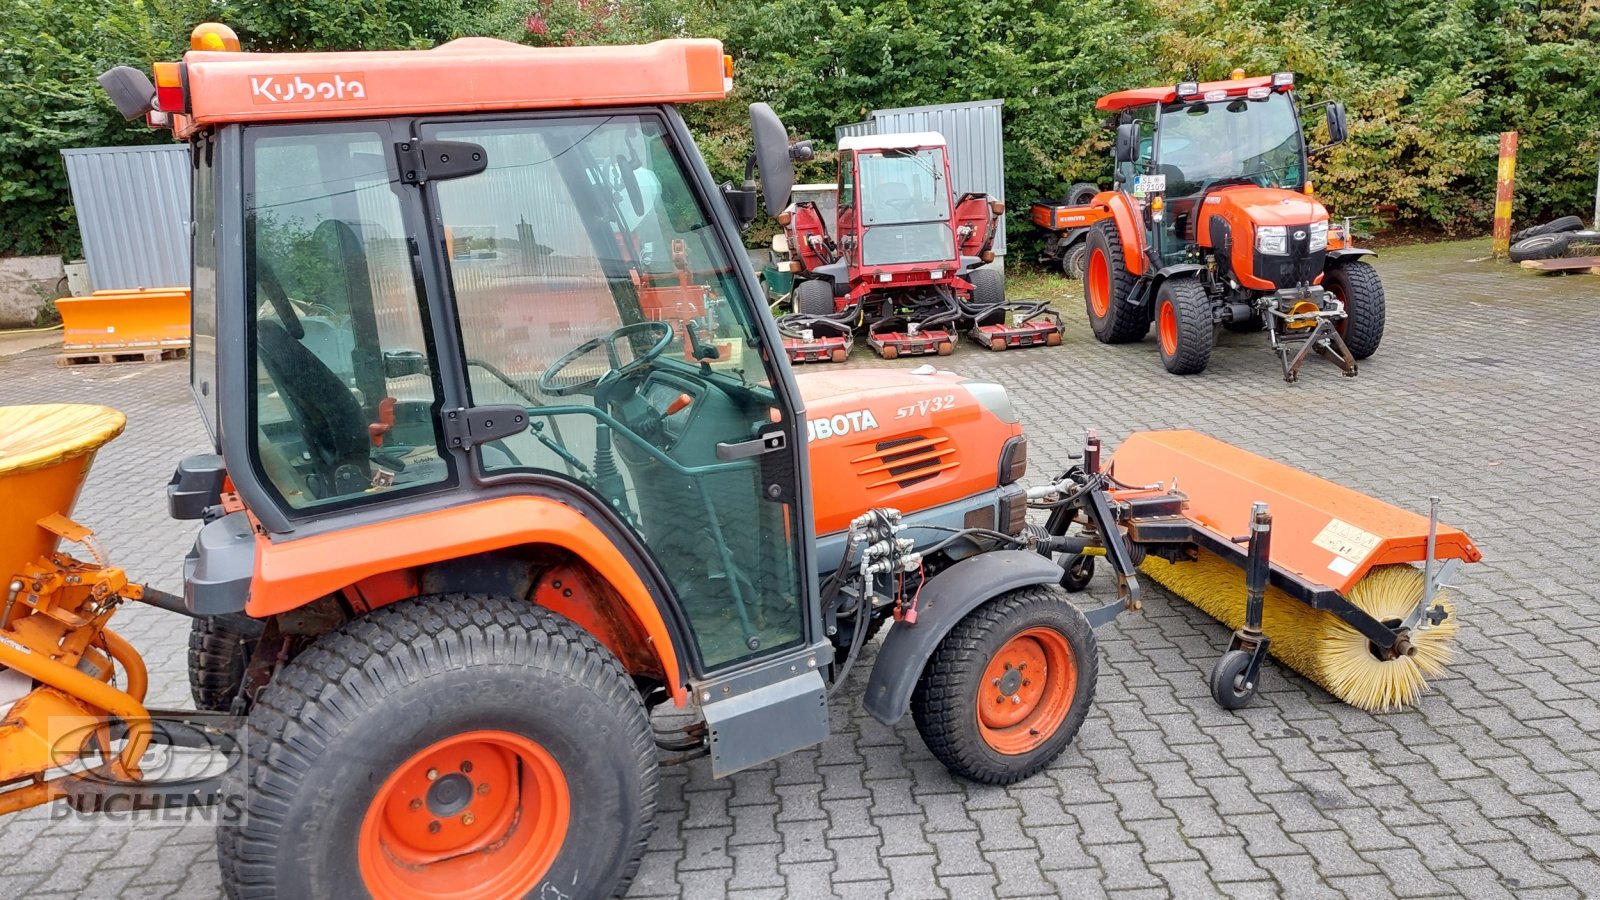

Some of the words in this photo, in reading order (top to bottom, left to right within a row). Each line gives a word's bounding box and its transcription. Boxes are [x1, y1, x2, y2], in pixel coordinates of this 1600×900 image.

[250, 74, 366, 102] Kubota
[1146, 183, 1165, 191] 2109
[894, 394, 956, 420] STV32
[806, 409, 879, 442] UBOTA
